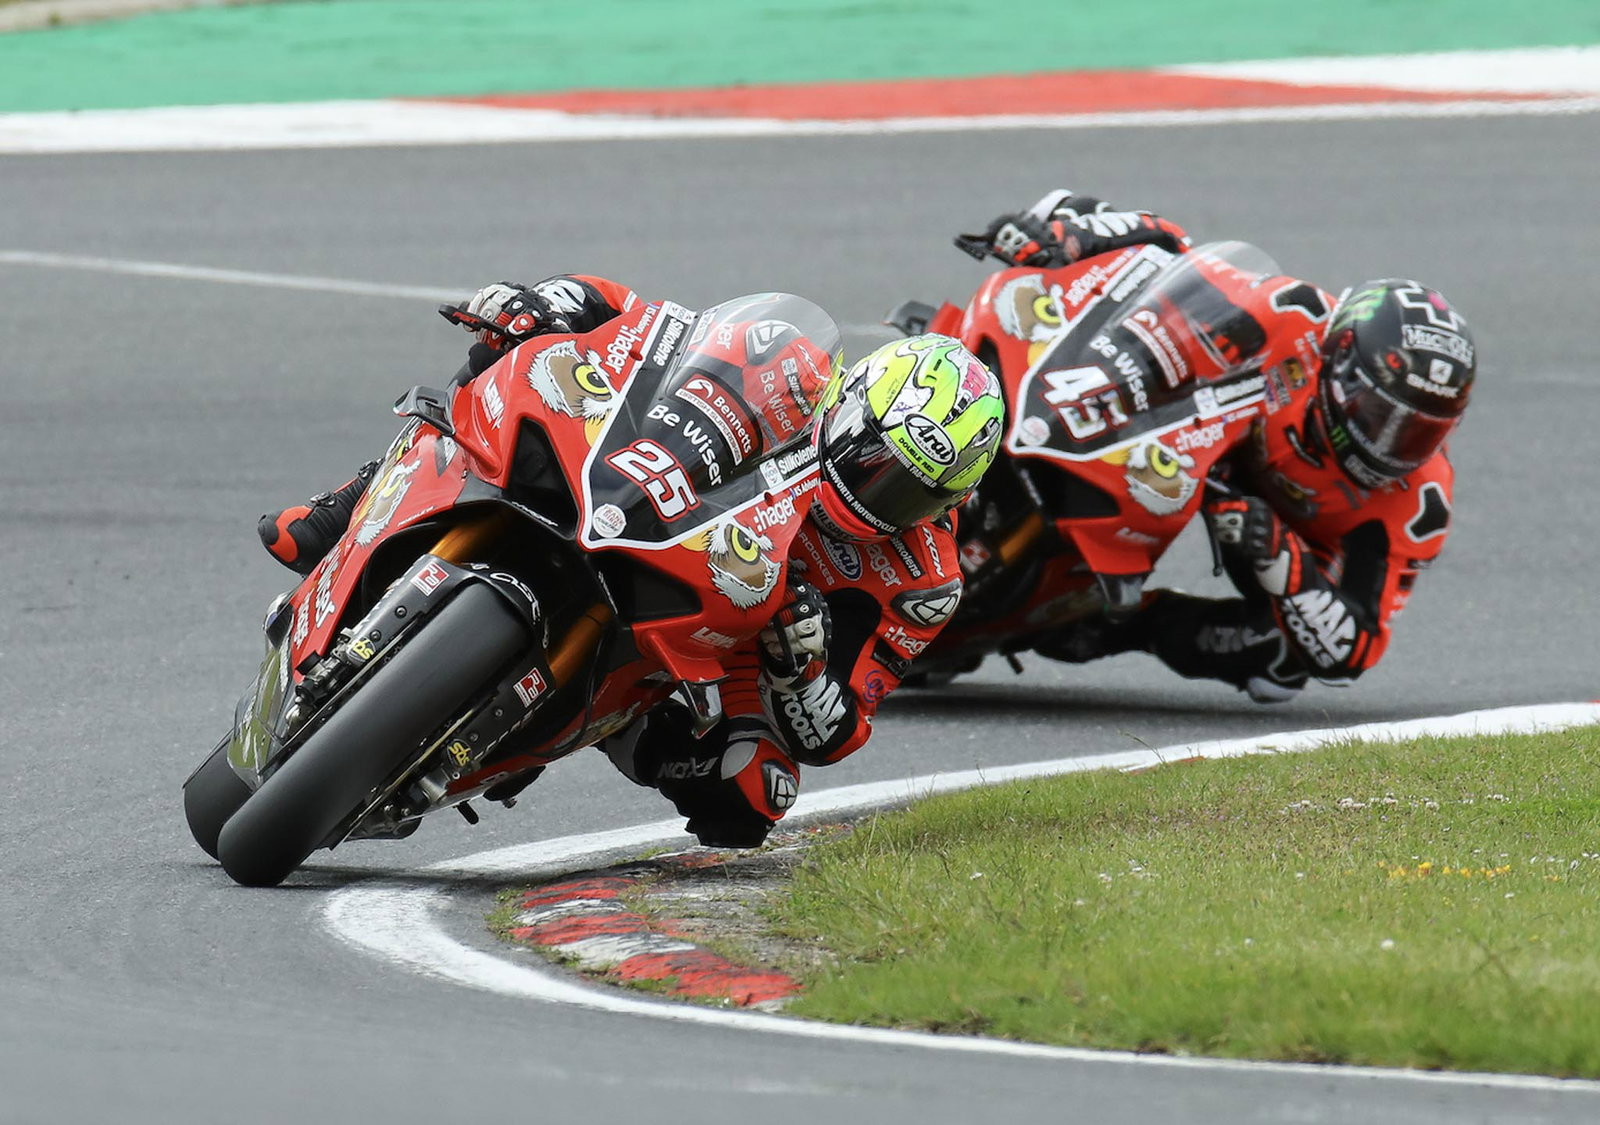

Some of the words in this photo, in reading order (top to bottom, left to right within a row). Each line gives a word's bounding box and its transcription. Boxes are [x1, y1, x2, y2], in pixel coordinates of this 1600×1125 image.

[1089, 335, 1118, 358] Be
[1114, 352, 1149, 411] Wiser
[647, 404, 680, 427] Be
[683, 420, 722, 486] Wiser
[713, 396, 752, 453] Bennetts
[907, 421, 953, 459] Arai
[606, 440, 699, 521] 25
[824, 459, 855, 503] TAMWORTH
